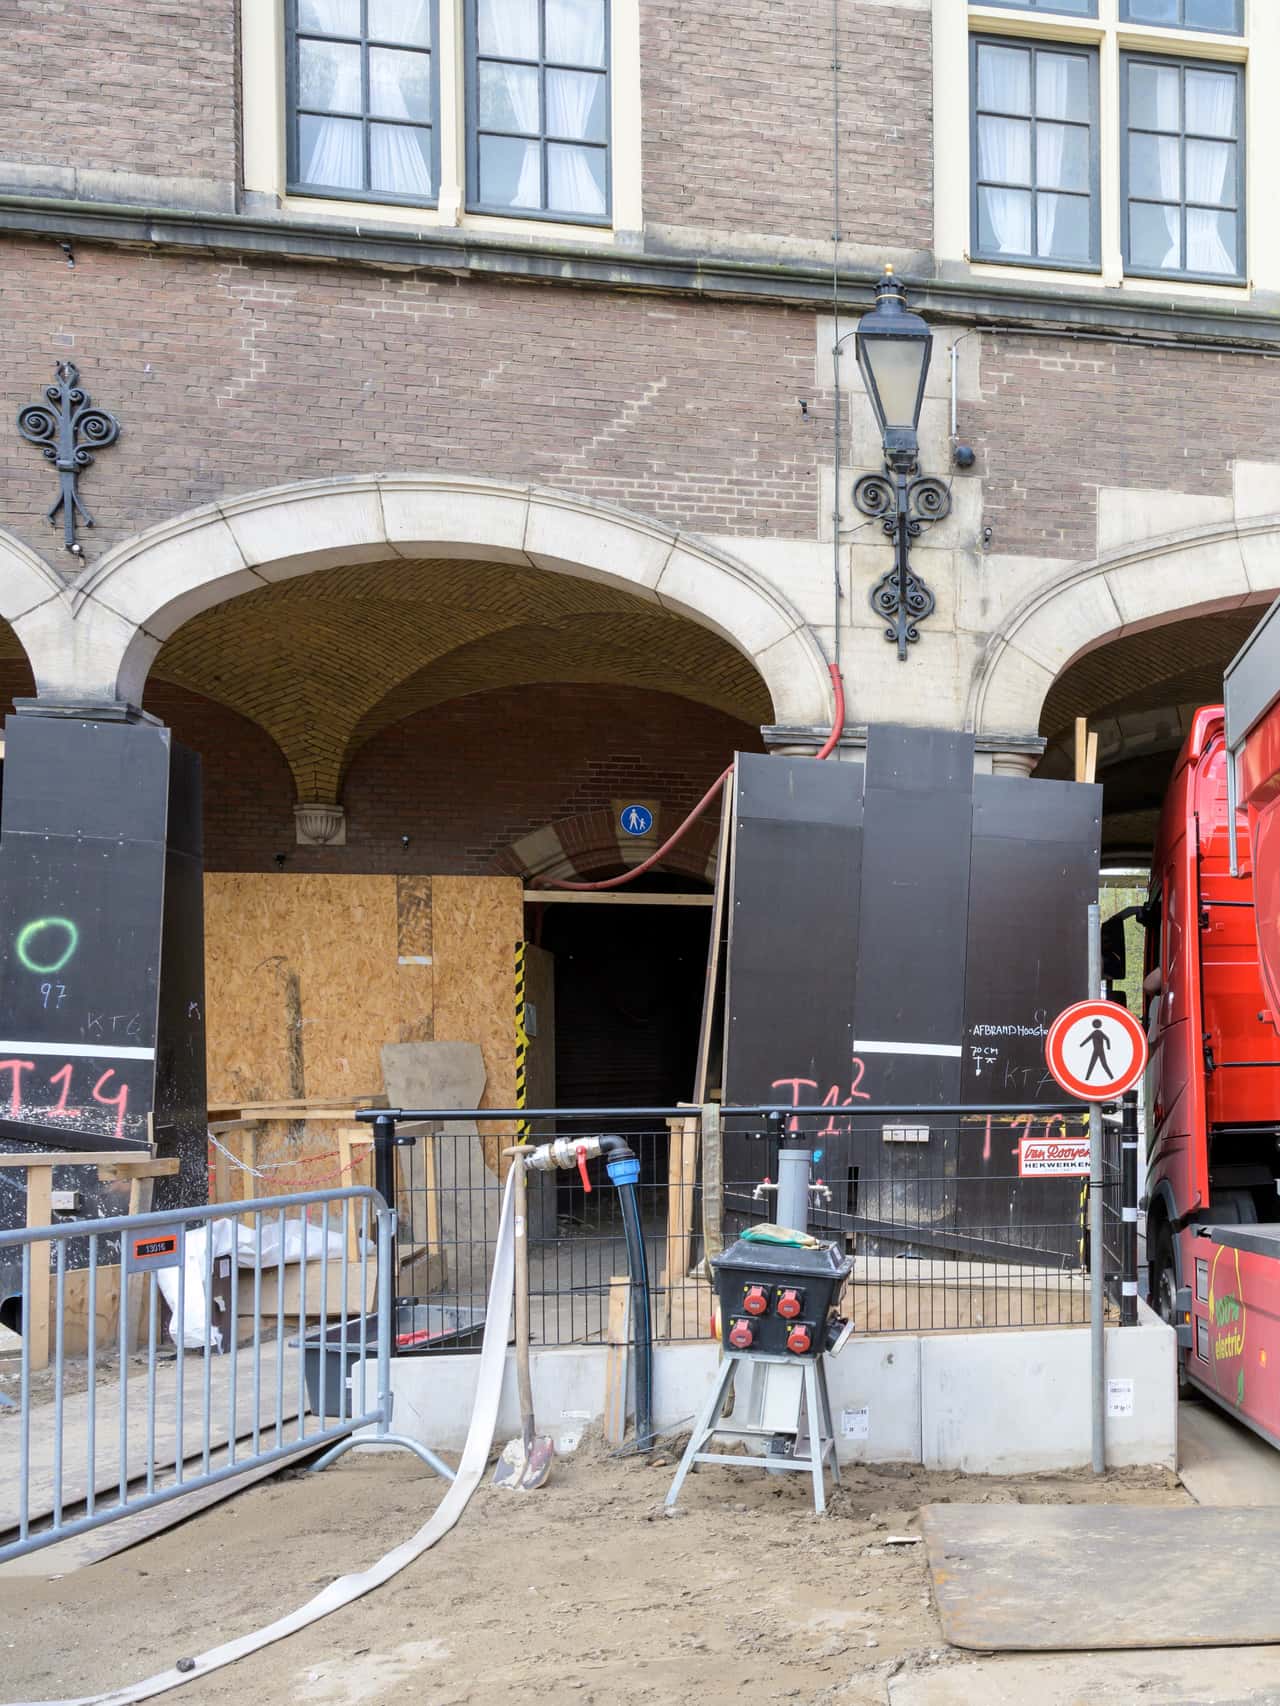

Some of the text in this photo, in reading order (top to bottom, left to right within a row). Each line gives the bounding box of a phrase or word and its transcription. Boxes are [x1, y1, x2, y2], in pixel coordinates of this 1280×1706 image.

[40, 982, 67, 1009] 97
[0, 1059, 128, 1139] T14
[1215, 1327, 1241, 1361] electric
